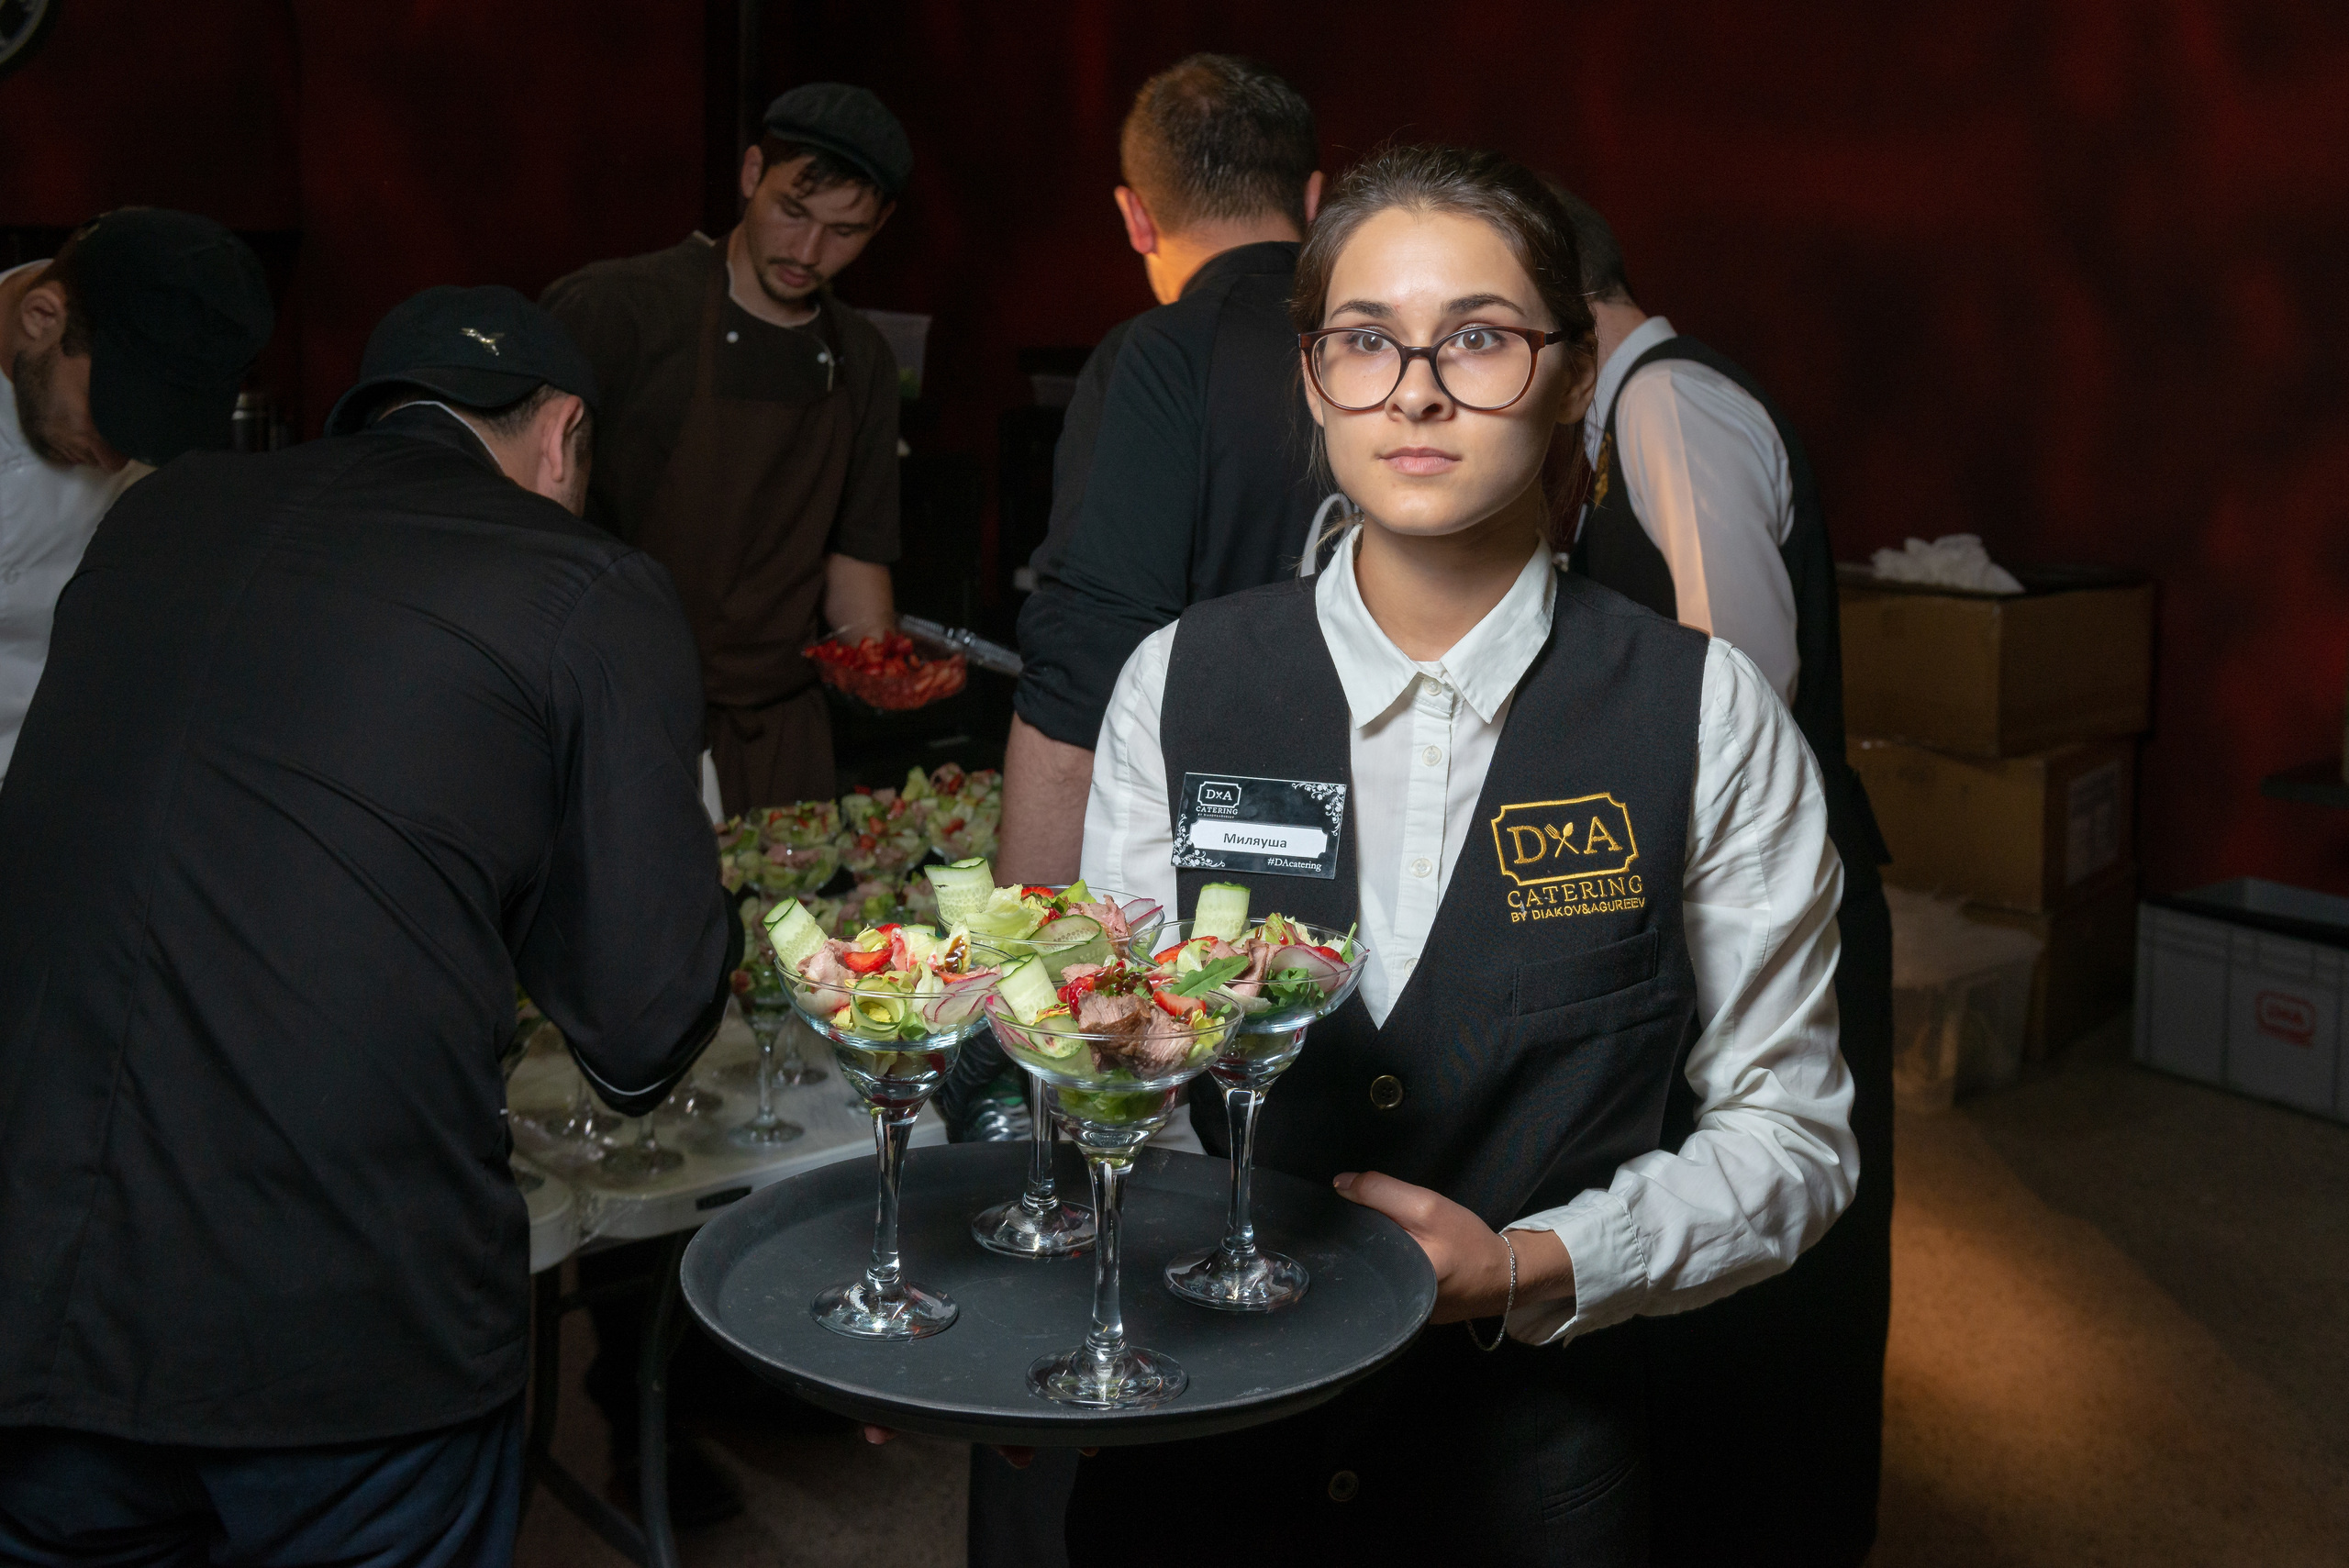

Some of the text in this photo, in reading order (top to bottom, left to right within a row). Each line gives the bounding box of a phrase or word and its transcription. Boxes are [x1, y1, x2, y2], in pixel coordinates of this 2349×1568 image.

[1196, 806, 1239, 815] CATERING
[1223, 832, 1287, 848] Миляуша
[1267, 858, 1322, 872] #DAcatering
[1507, 874, 1644, 908] CATERING
[1510, 896, 1645, 923] BY DIAKOV&AGUREEV
